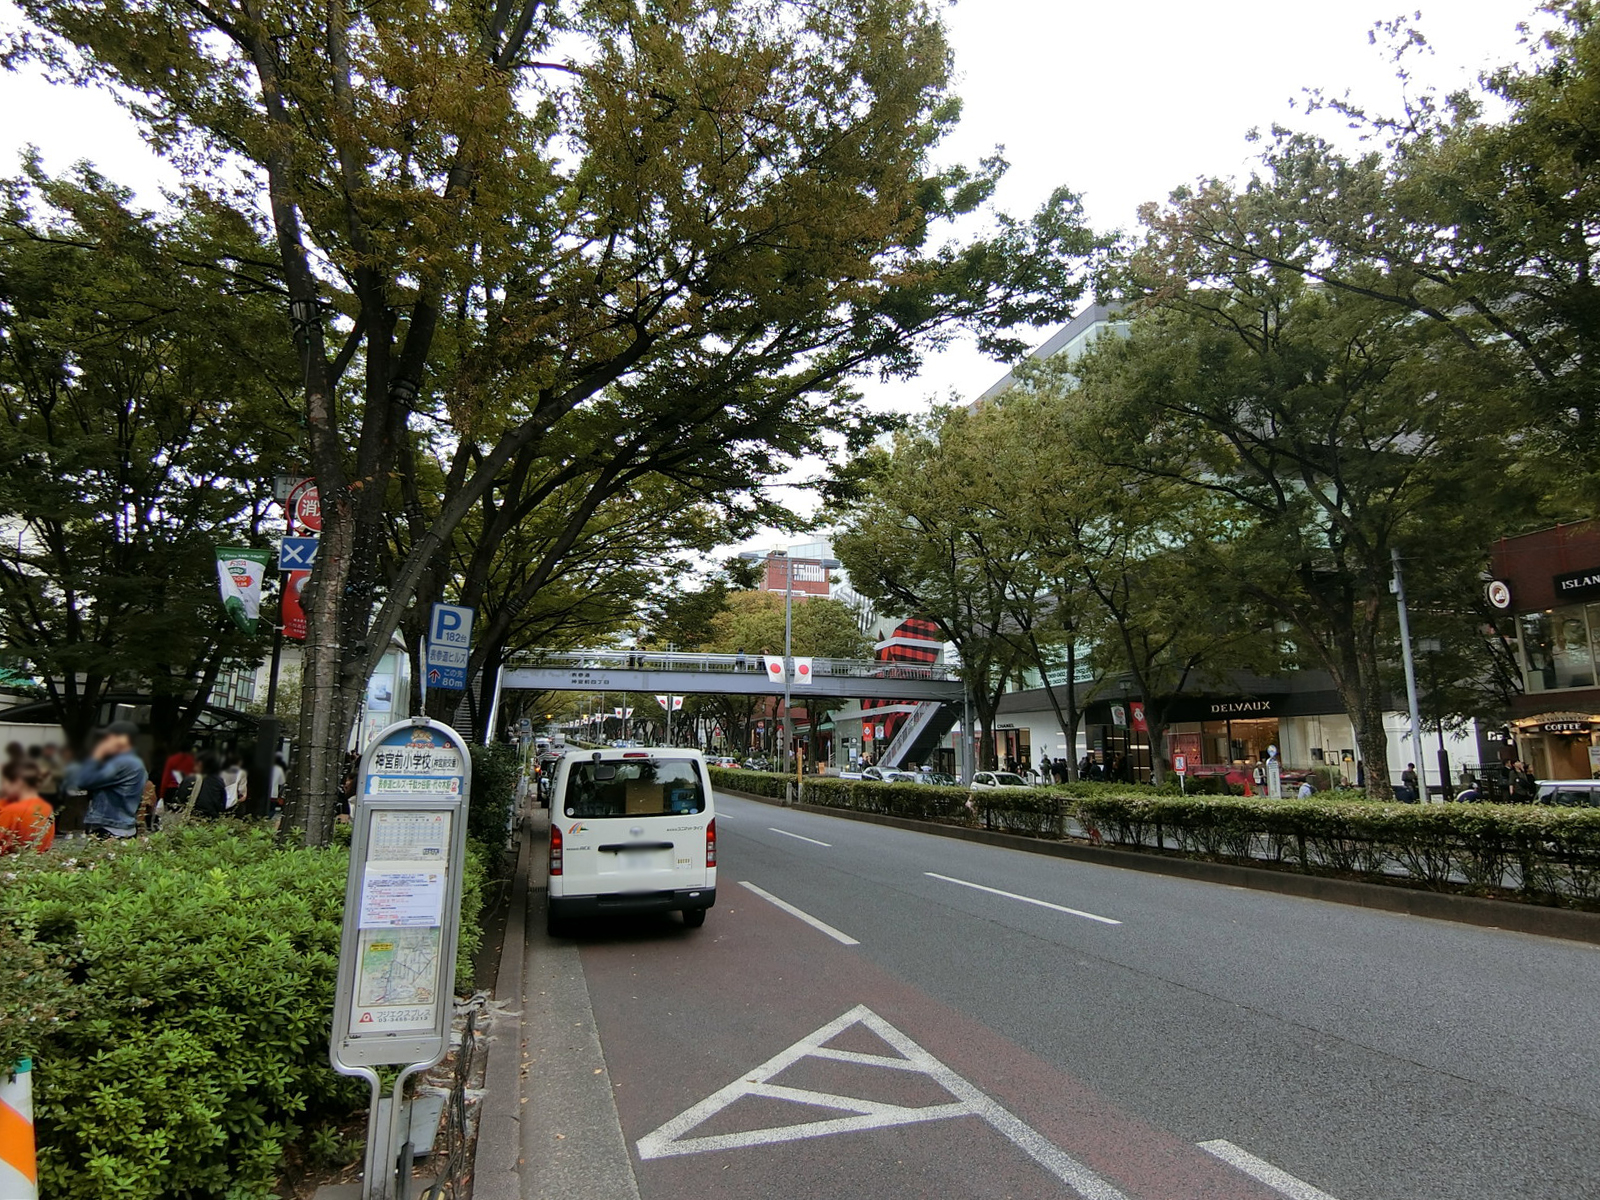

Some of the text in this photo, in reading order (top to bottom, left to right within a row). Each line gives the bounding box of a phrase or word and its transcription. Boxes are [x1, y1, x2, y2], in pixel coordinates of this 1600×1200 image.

[436, 609, 461, 640] P
[446, 632, 467, 643] 182台
[430, 649, 466, 664] 表参道ヒルズ
[444, 668, 464, 678] この先
[442, 678, 463, 687] 80m
[1211, 701, 1271, 713] DELVAUX
[1544, 723, 1582, 731] COFFEE
[375, 752, 432, 770] 神宮前小学校
[377, 1009, 431, 1019] フジエクスプレス
